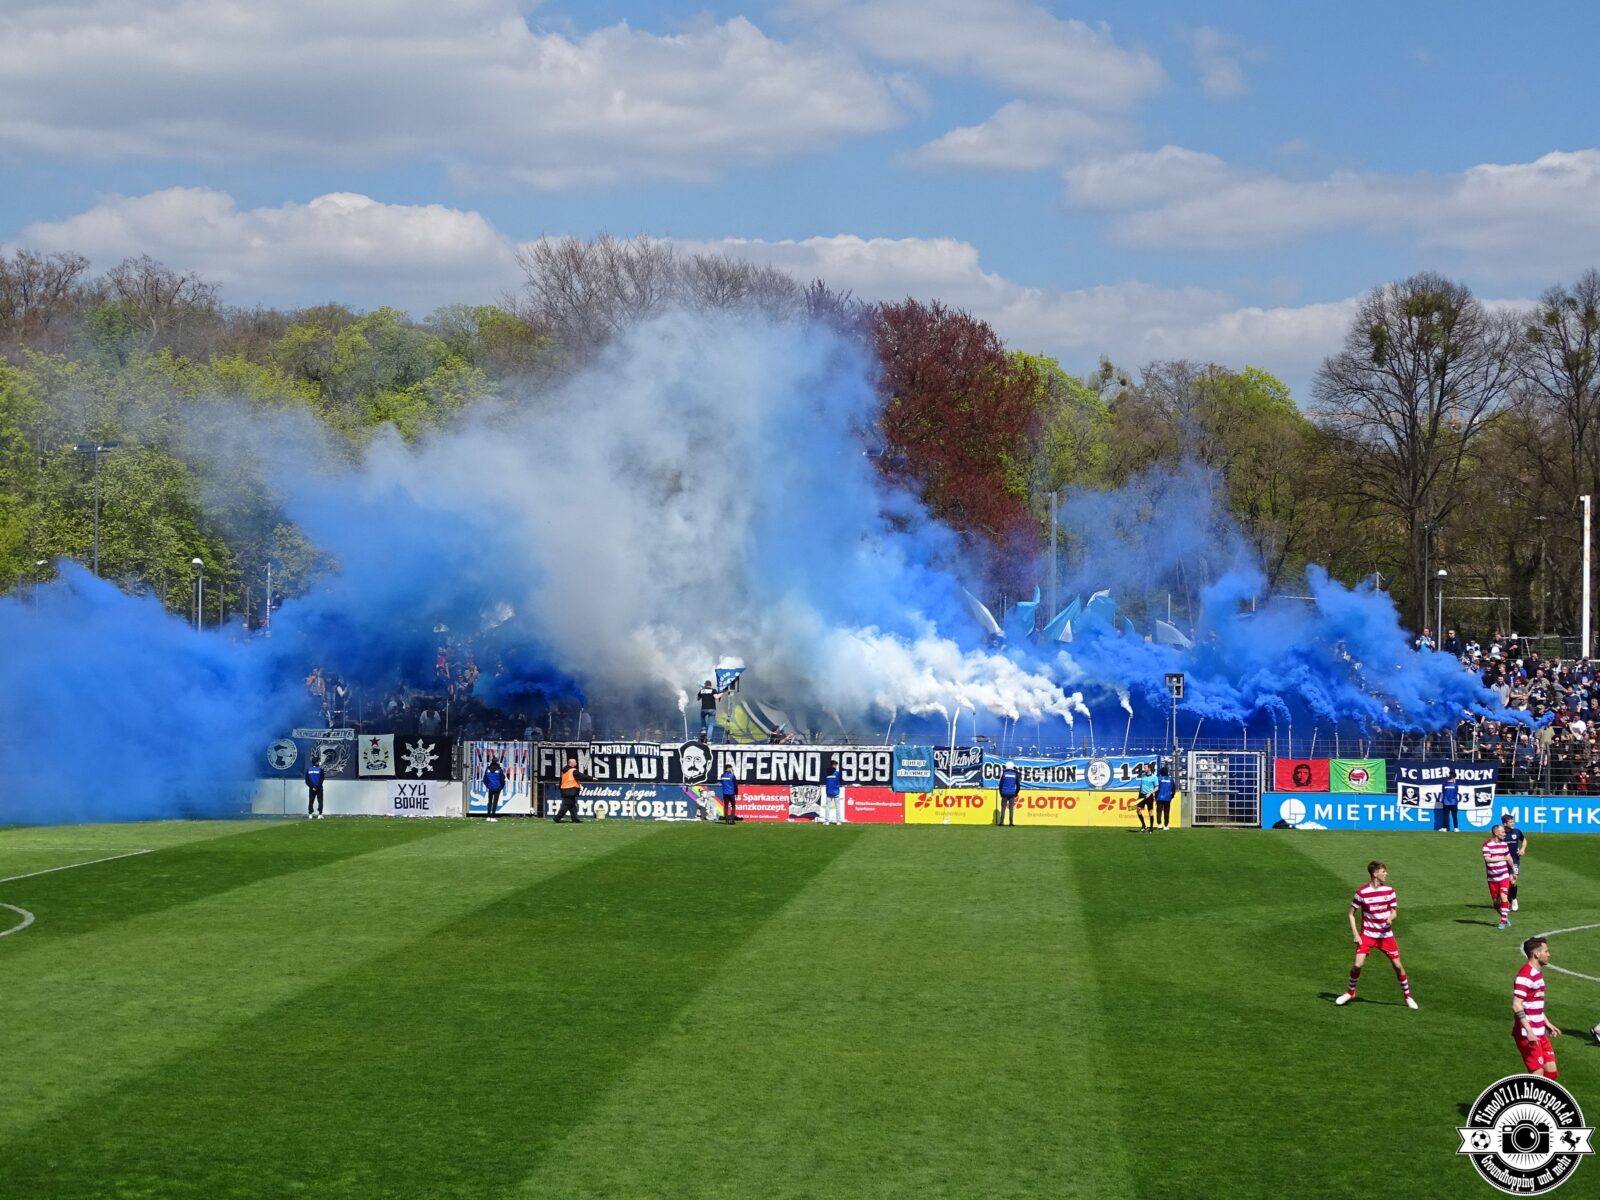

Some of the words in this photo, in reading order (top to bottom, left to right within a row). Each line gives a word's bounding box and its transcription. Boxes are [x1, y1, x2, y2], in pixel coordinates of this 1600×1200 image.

[590, 744, 632, 755] FILMSTADT
[634, 744, 660, 757] YOUTH
[717, 751, 821, 782] INFERNO
[831, 752, 891, 782] 1999
[984, 762, 1077, 783] CONECTION
[1400, 767, 1418, 780] FC
[1421, 766, 1450, 780] BIER
[1455, 768, 1494, 781] HOL'N
[624, 788, 657, 801] gegen
[547, 799, 688, 817] HMOPHOBIE
[734, 802, 787, 813] nanzkonzept.
[935, 795, 984, 809] LOTTO
[1027, 796, 1077, 810] LOTTO
[1314, 803, 1431, 823] MIETHKE
